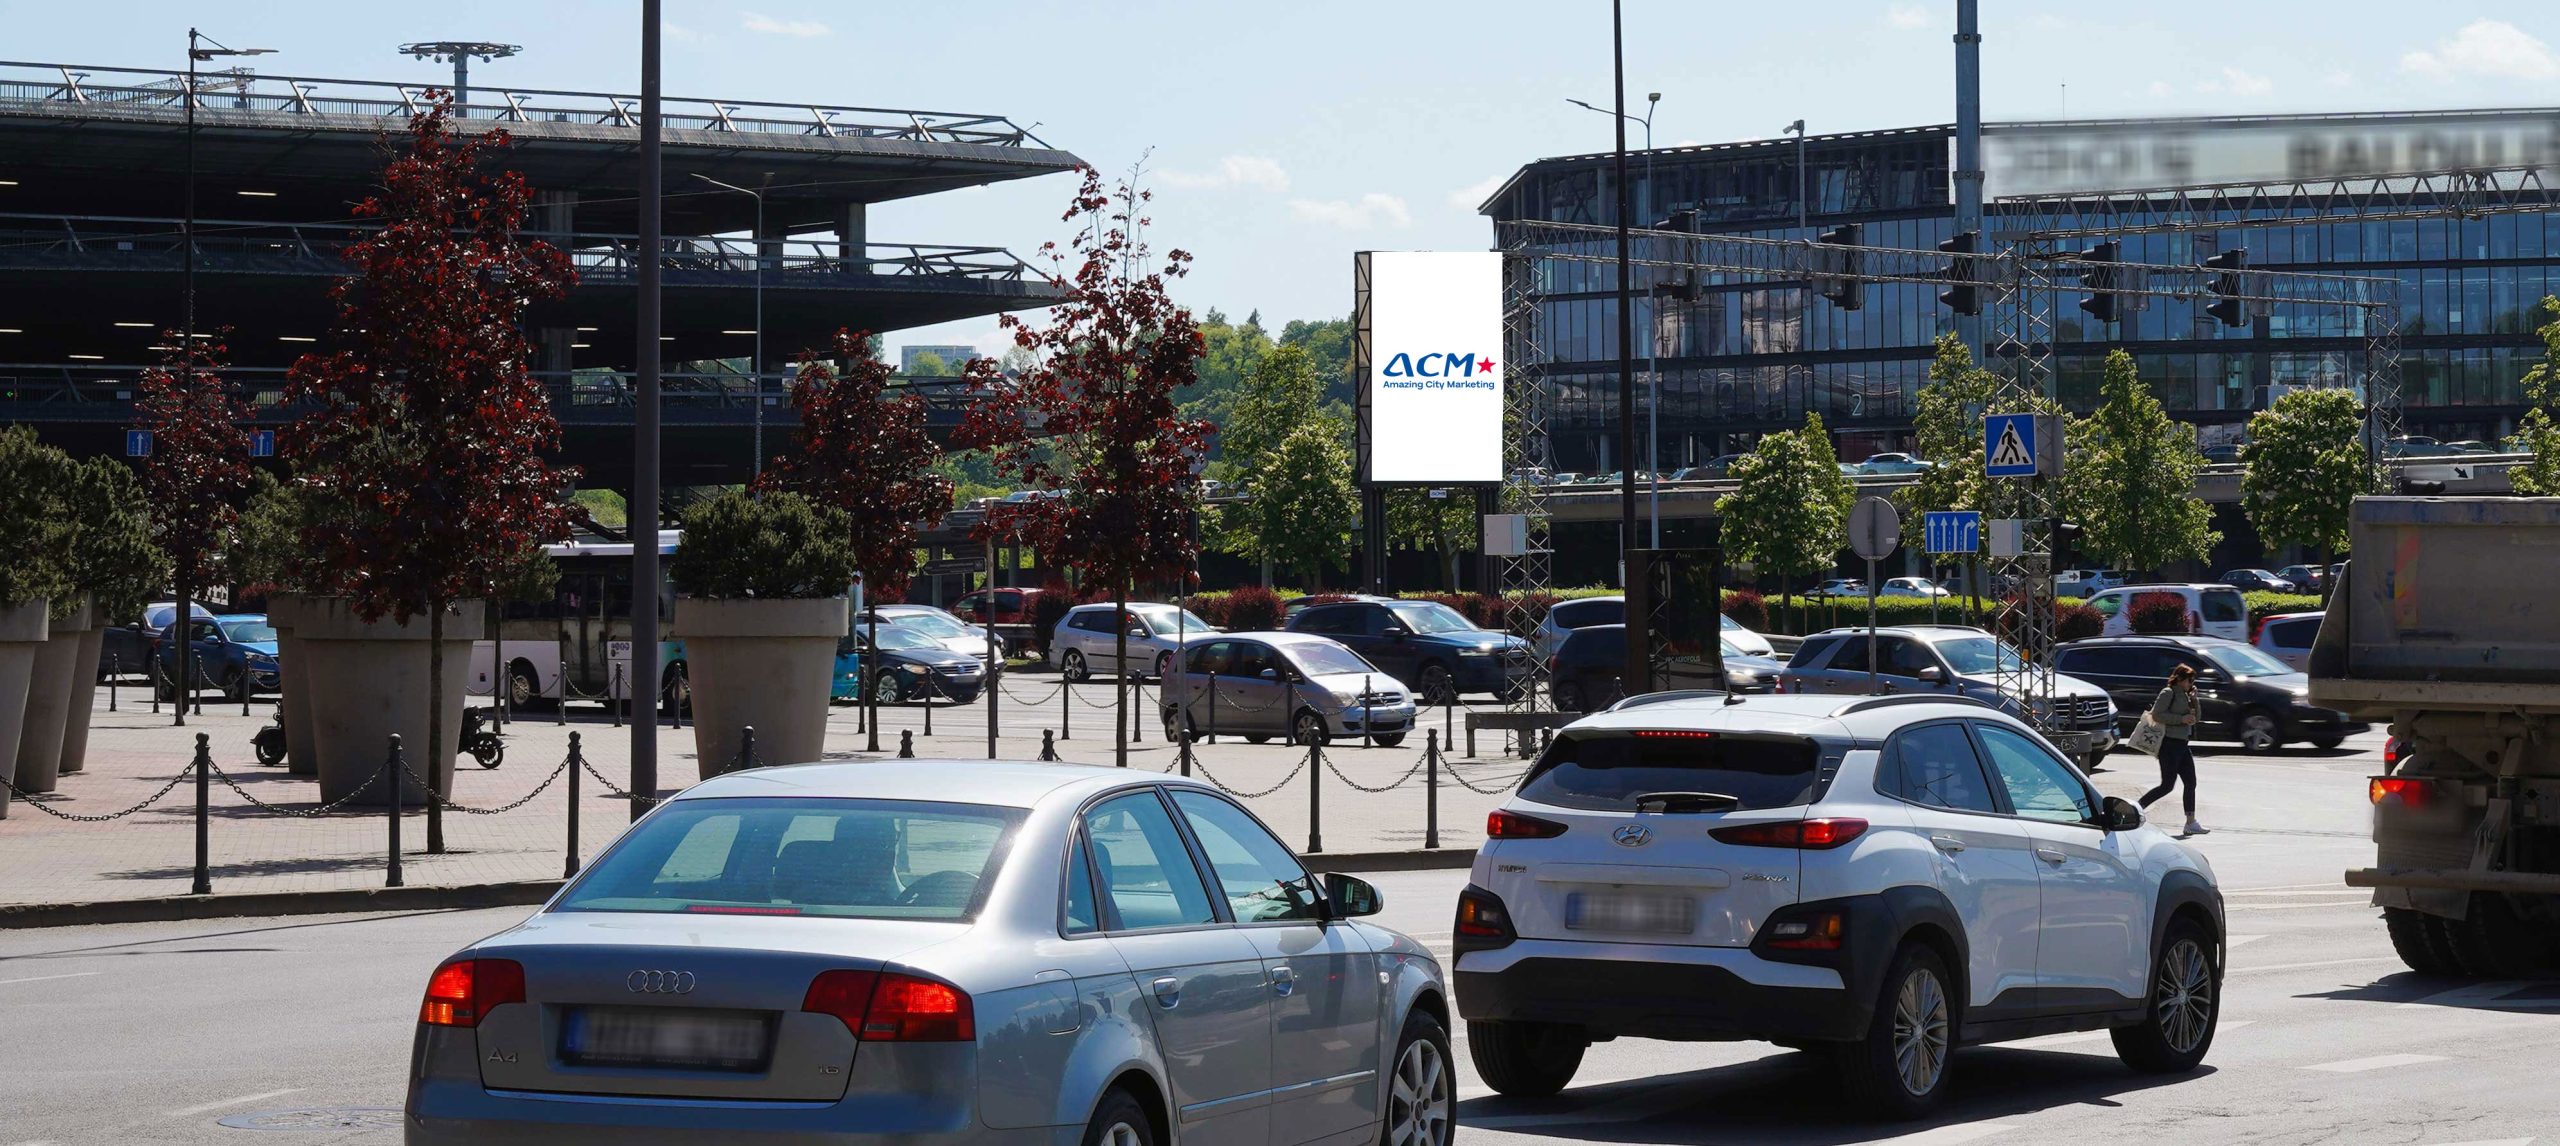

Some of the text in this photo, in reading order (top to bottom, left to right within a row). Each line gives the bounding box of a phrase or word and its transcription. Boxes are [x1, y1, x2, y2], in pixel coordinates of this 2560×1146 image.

[1382, 352, 1475, 377] ACM
[1383, 380, 1495, 391] Amazing City Marketing
[1851, 393, 1862, 416] 2
[487, 1047, 519, 1064] A4
